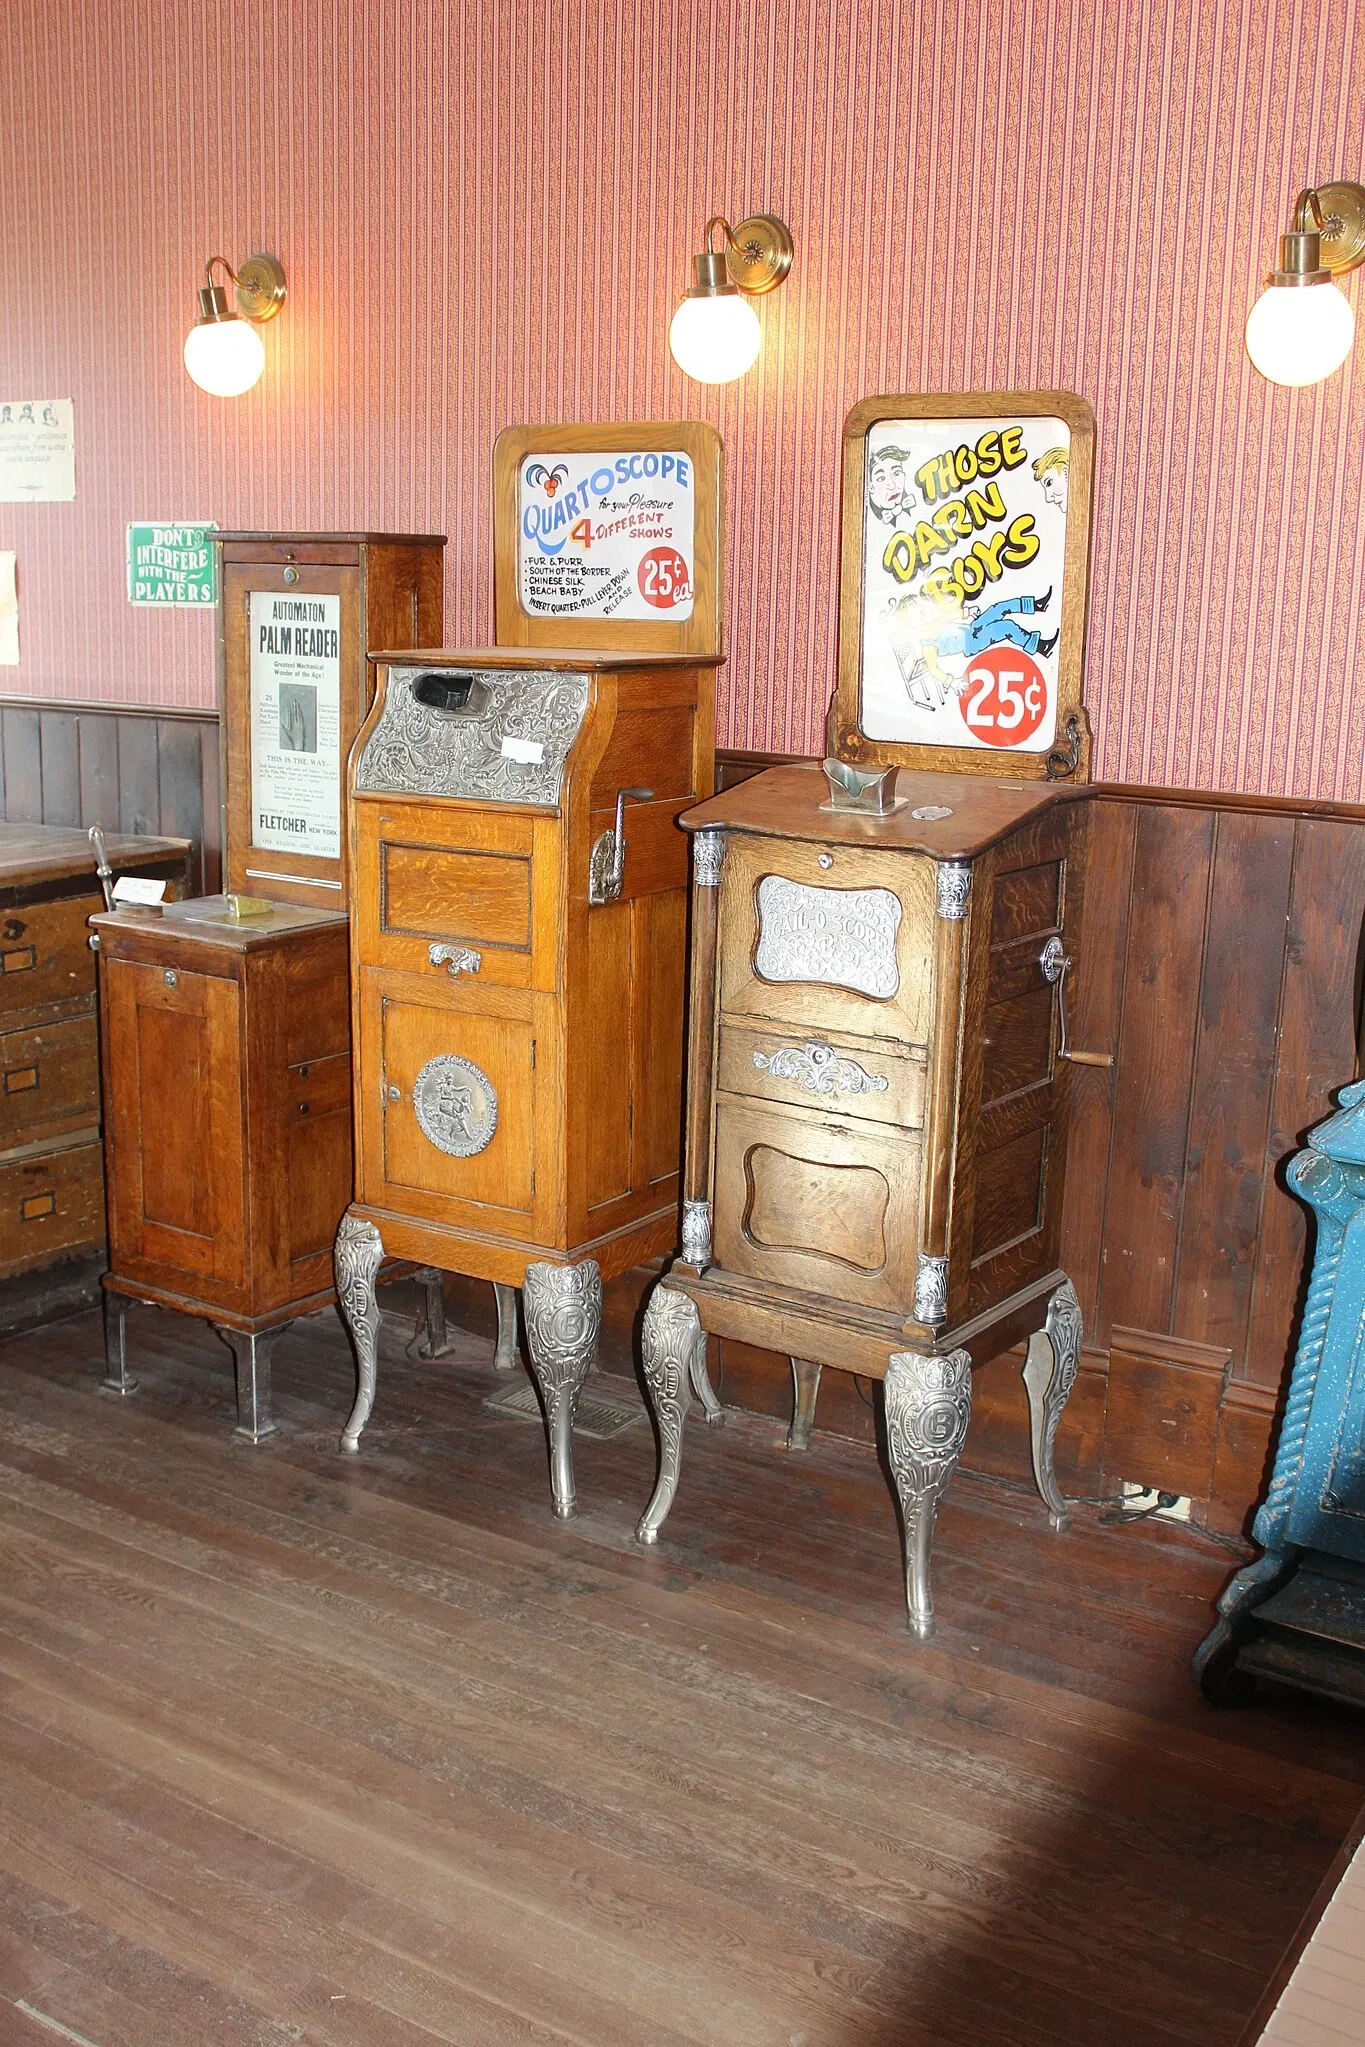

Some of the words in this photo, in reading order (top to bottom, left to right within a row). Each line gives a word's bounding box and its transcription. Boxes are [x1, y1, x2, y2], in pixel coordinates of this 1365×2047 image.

[914, 426, 1028, 504] THOSE
[523, 454, 688, 556] QUARTOSCOPE
[598, 497, 611, 510] for
[611, 501, 629, 513] your
[628, 493, 674, 514] Pleasure
[569, 518, 596, 551] 4
[596, 512, 664, 540] DIFFERENT
[628, 527, 673, 539] SHOWS
[882, 481, 1008, 583] DARN
[137, 545, 209, 571] INTERFERE
[528, 557, 546, 566] FUR
[550, 557, 557, 566] &
[557, 557, 584, 567] PURR
[922, 514, 1040, 609] BOYS
[138, 565, 163, 579] WITH
[164, 567, 188, 583] THE
[529, 567, 555, 576] SOUTH
[555, 567, 566, 576] OF
[566, 567, 580, 576] THE
[580, 566, 612, 576] BORDER
[529, 576, 562, 585] CHINESE
[565, 577, 586, 586] SILK
[644, 555, 682, 596] 25¢
[135, 582, 211, 602] PLAYERS
[528, 597, 550, 612] INSERT
[551, 601, 580, 615] QUARTER
[580, 596, 596, 609] PULL
[595, 583, 614, 601] LEVER
[610, 567, 631, 587] DOWN
[529, 586, 557, 596] BEACH
[560, 586, 584, 597] BABY
[602, 586, 633, 616] RELEASE
[608, 585, 623, 601] AND
[272, 600, 326, 623] AUTOMATON
[259, 625, 292, 655] PALM
[294, 627, 338, 659] READER
[273, 660, 295, 669] Greatest
[296, 662, 325, 671] Mechanical
[273, 668, 293, 677] Wonder
[301, 670, 310, 678] the
[966, 668, 1043, 729] 25¢
[266, 754, 283, 763] THIS
[284, 756, 291, 764] IS
[293, 757, 309, 765] THE
[259, 813, 307, 834] FLETCHER
[308, 827, 321, 835] NEW
[322, 828, 338, 837] YORK
